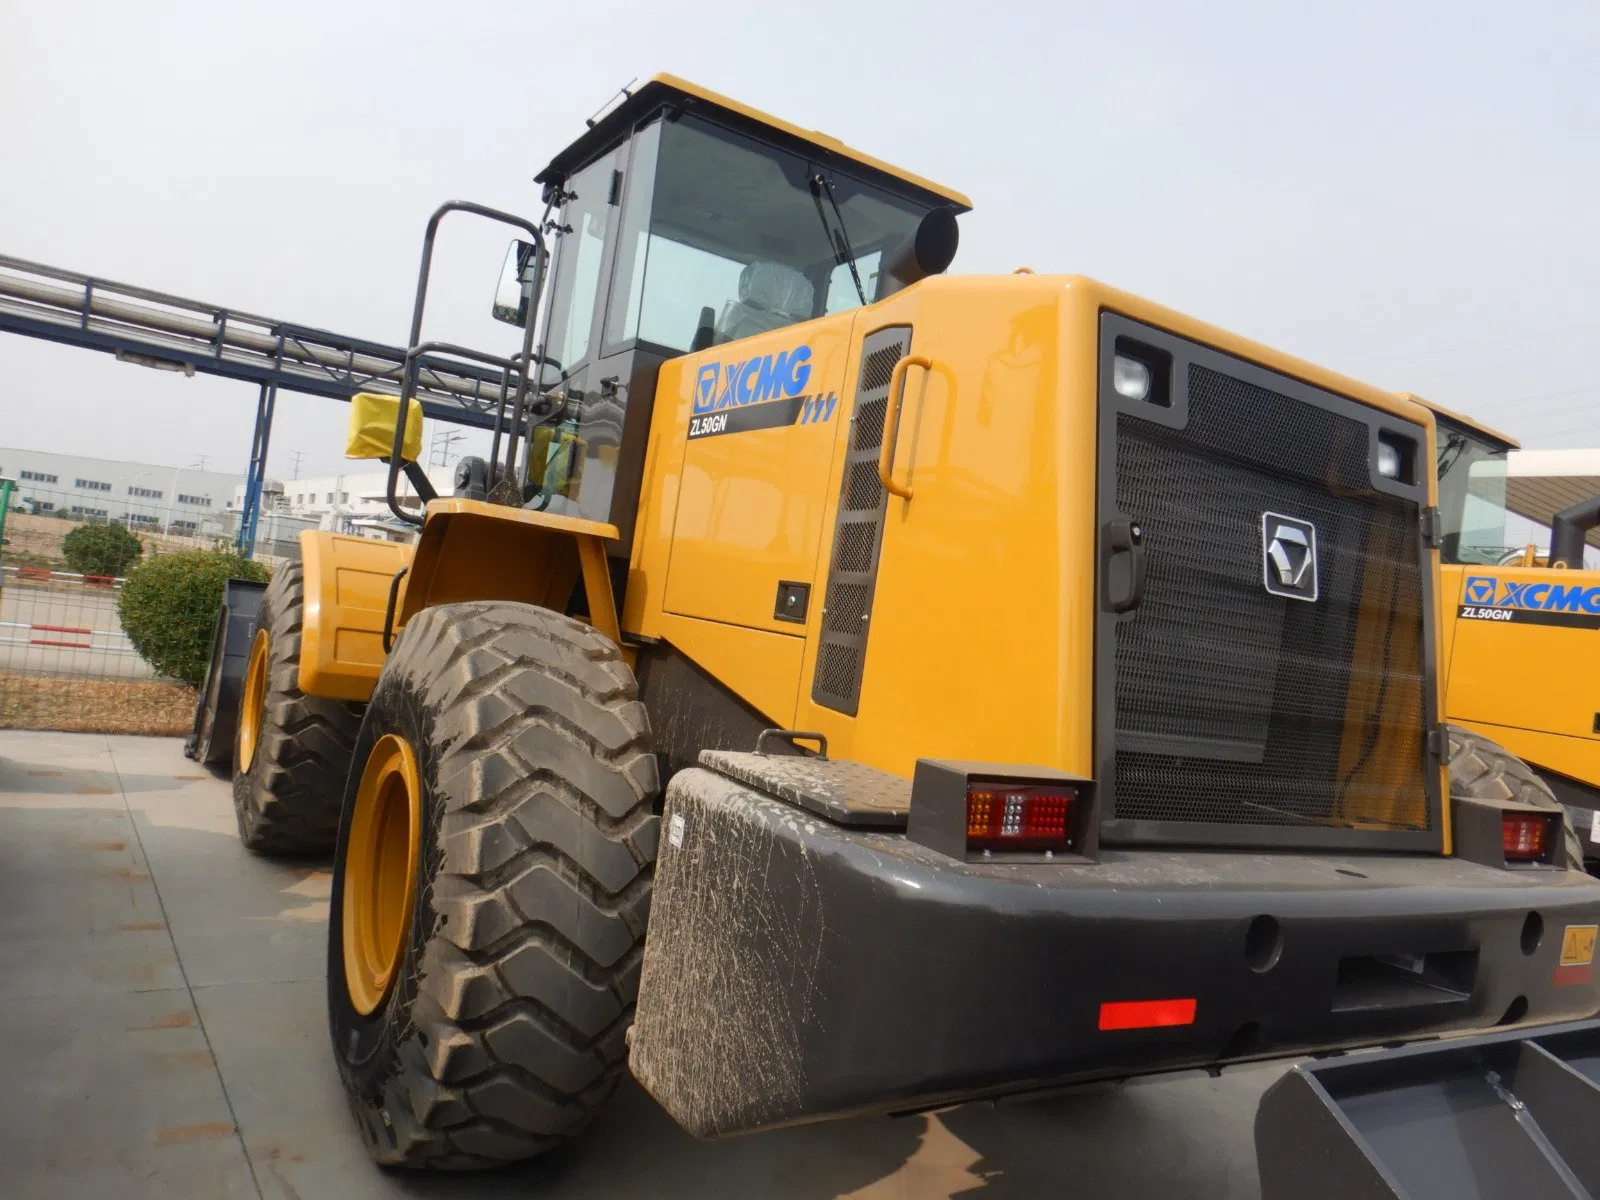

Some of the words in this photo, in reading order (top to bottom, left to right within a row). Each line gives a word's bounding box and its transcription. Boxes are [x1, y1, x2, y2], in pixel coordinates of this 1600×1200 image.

[714, 345, 812, 409] XCMG
[689, 414, 728, 436] ZL50GN
[1461, 606, 1513, 621] ZL50GN
